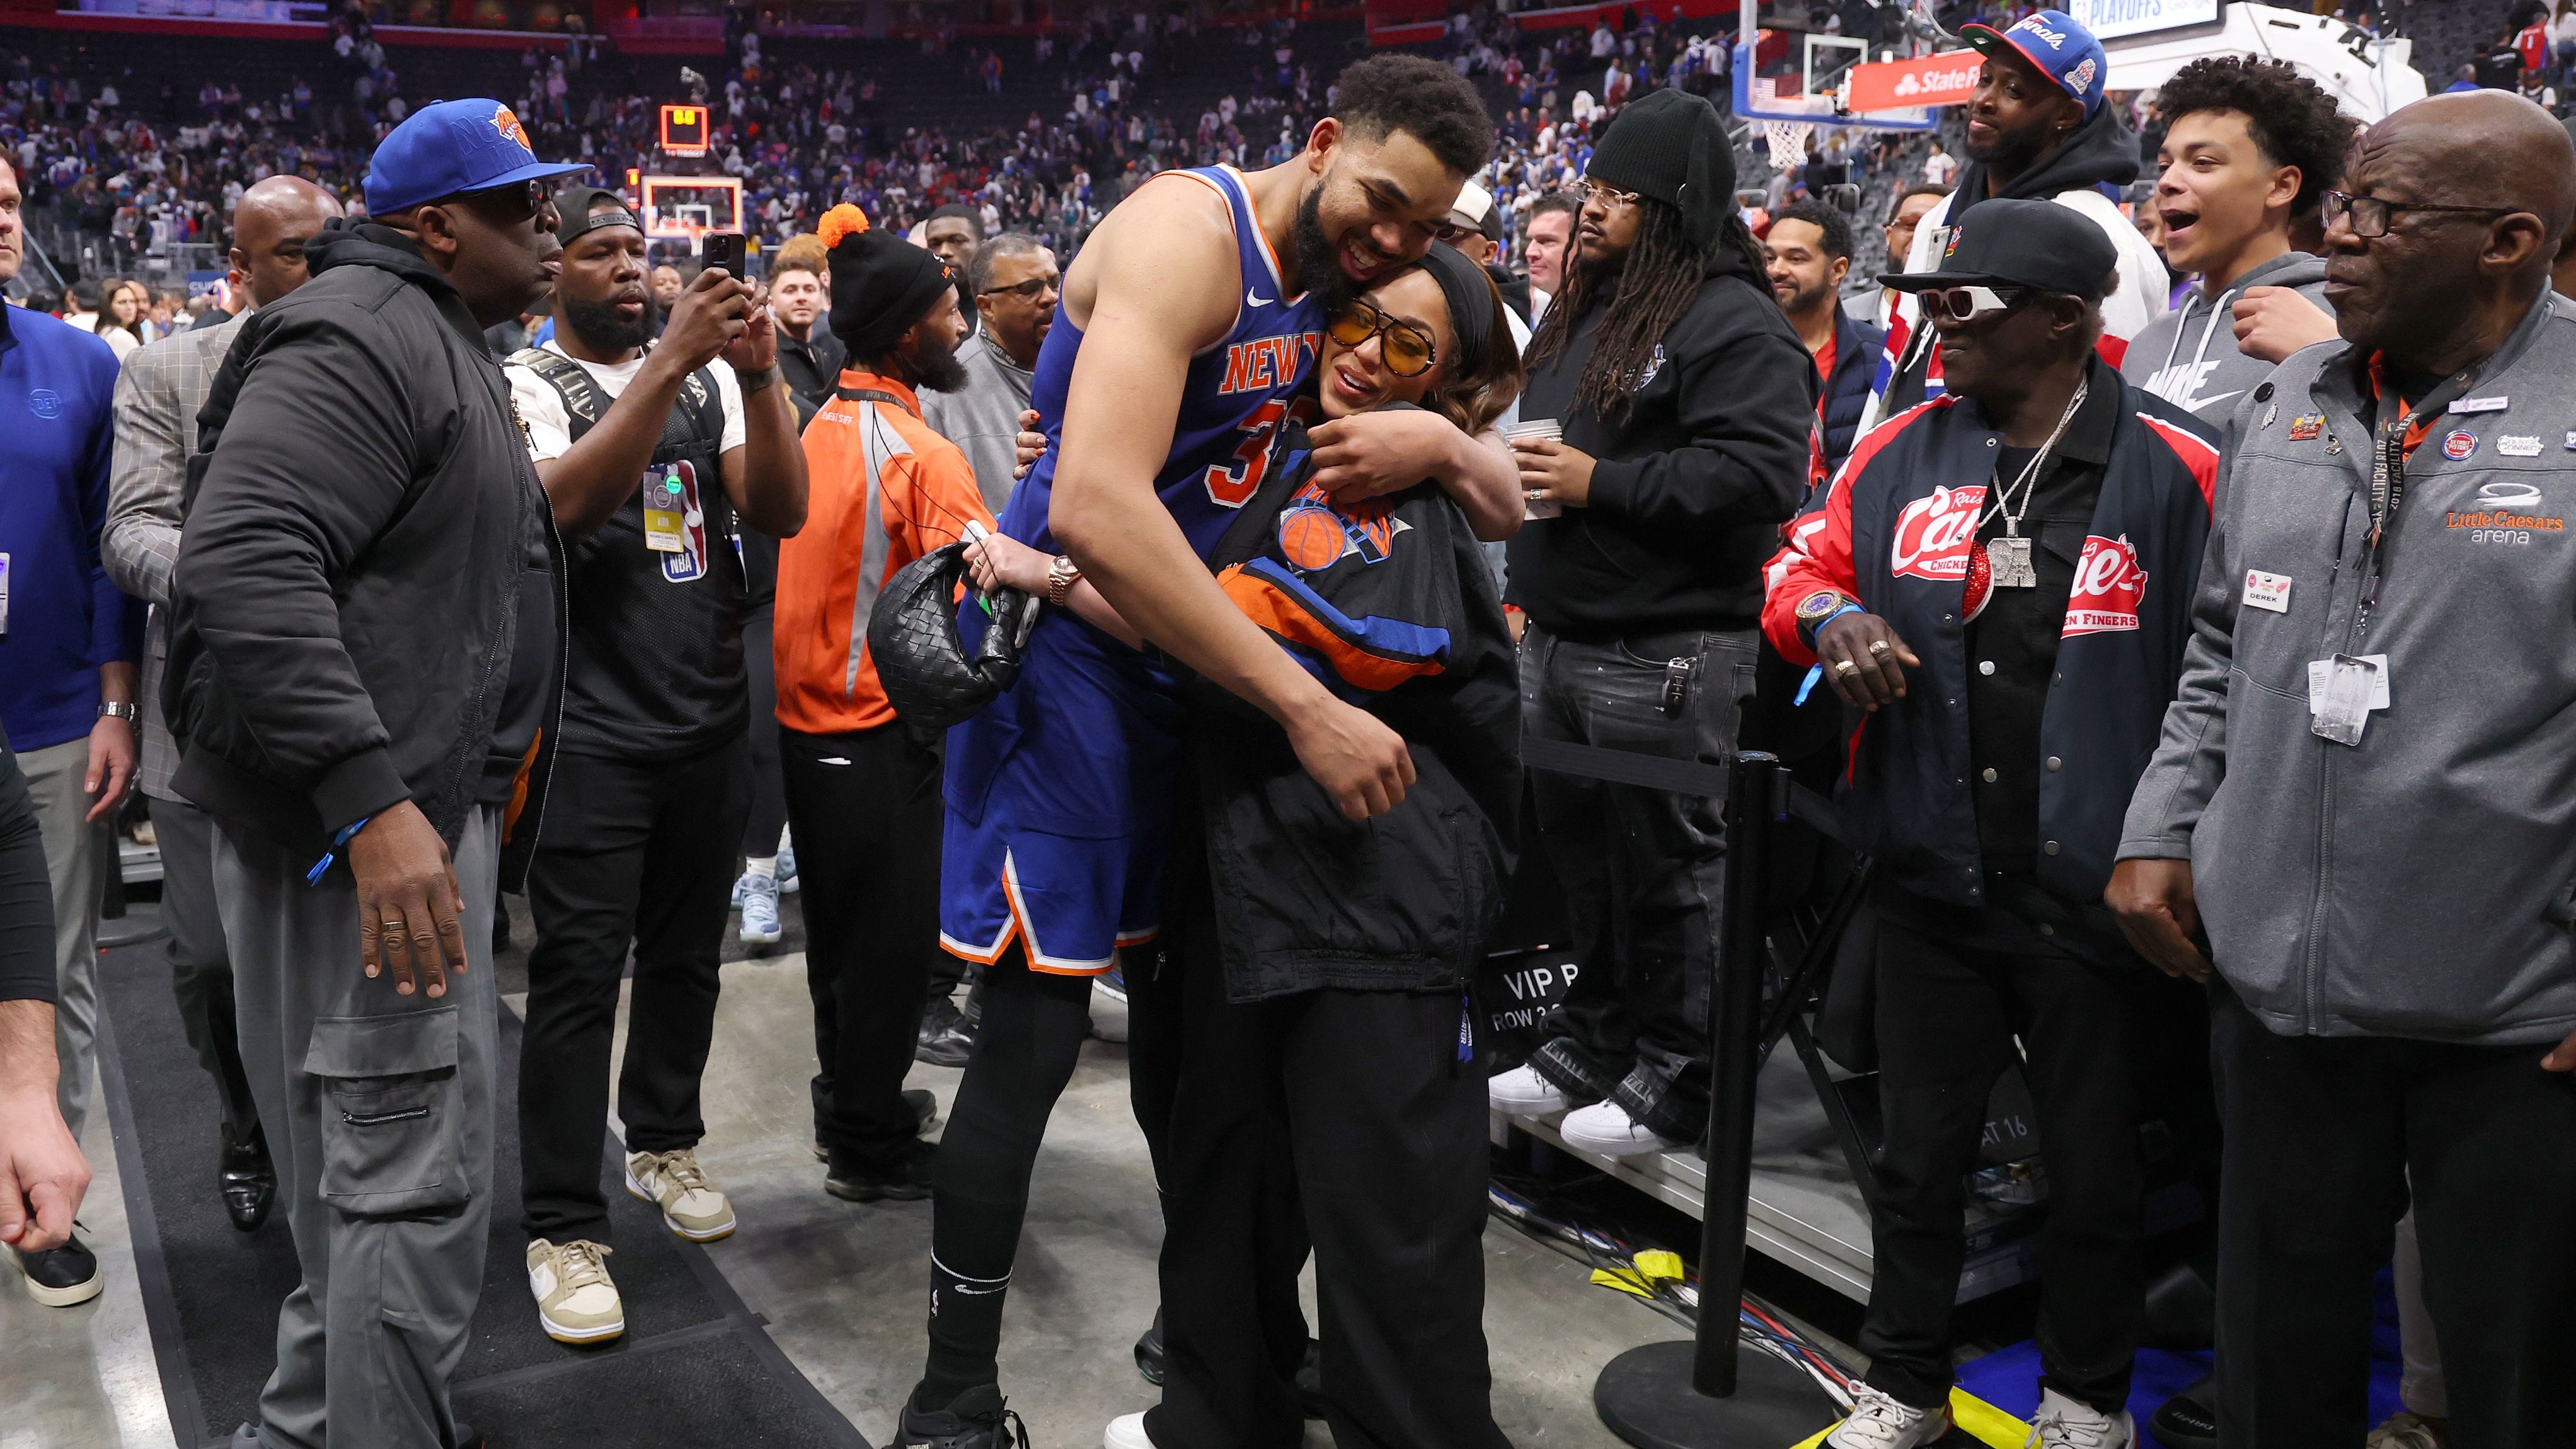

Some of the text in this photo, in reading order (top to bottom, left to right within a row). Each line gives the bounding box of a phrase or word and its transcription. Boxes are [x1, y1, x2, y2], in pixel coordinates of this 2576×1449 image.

[2090, 0, 2161, 27] PLAYOFFS
[1217, 334, 1302, 396] NEW
[2142, 359, 2222, 410] NIKE
[2395, 413, 2421, 432] YEAR
[2389, 439, 2403, 484] FACILITY
[2371, 462, 2388, 503] FACILITY
[2389, 486, 2402, 510] 2018
[2446, 510, 2563, 531] Little Caesars
[2471, 529, 2530, 545] arena
[669, 552, 693, 574] NBA
[2250, 593, 2277, 603] DEREK
[1503, 968, 1553, 1000] VIP
[1492, 1008, 1532, 1031] ROW
[2004, 1115, 2028, 1139] 16
